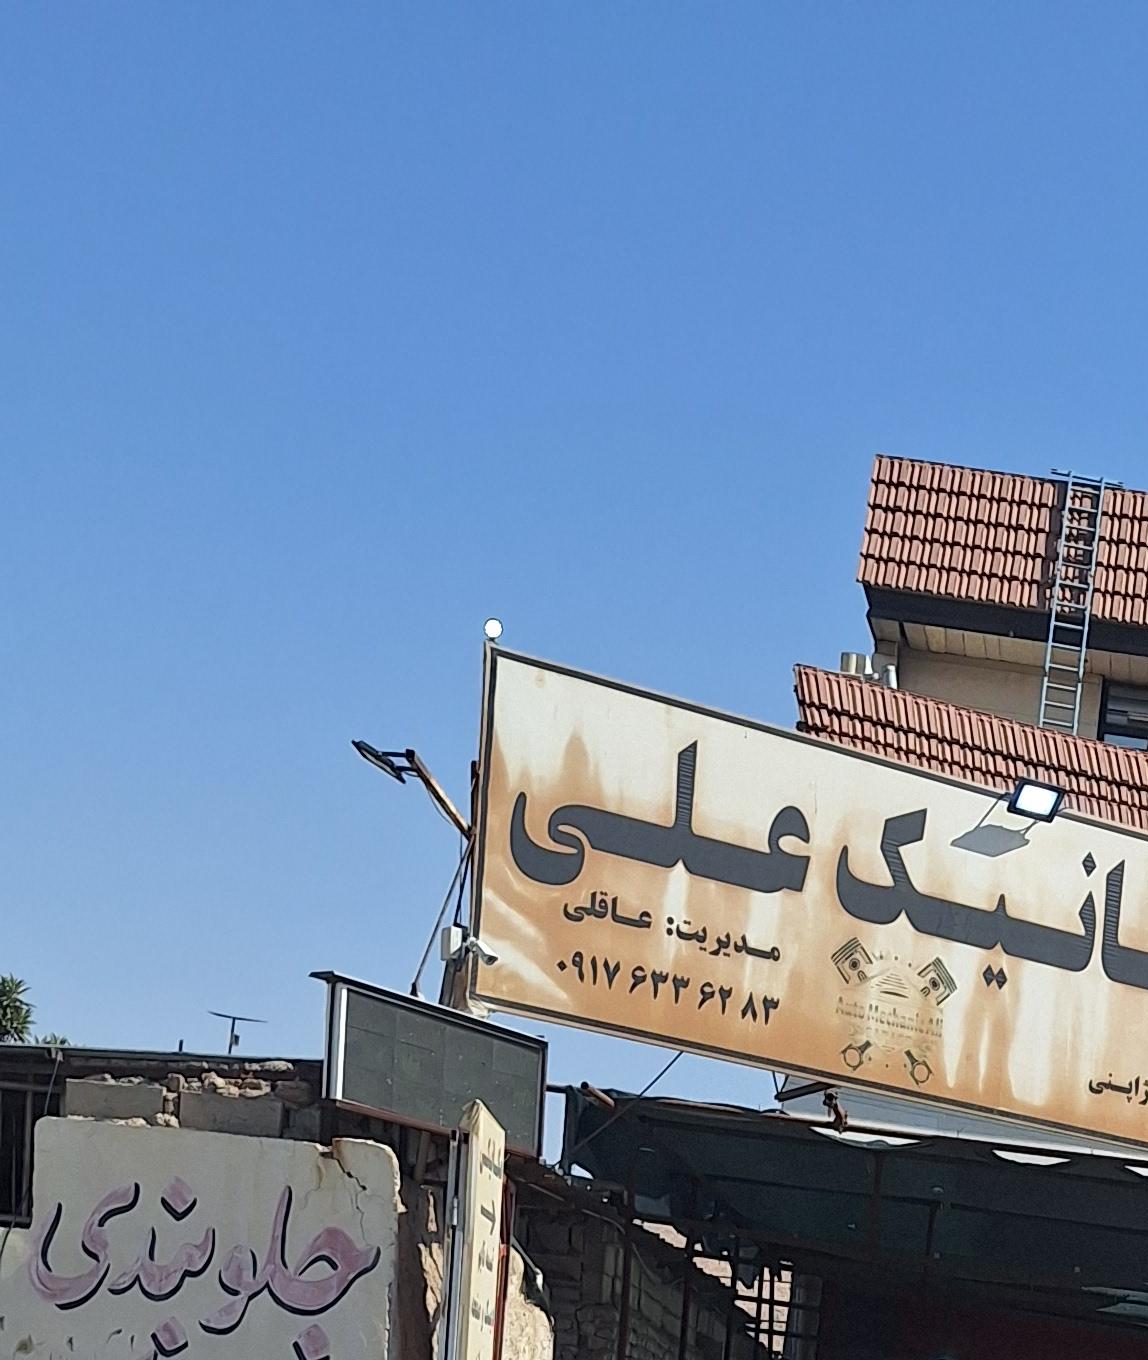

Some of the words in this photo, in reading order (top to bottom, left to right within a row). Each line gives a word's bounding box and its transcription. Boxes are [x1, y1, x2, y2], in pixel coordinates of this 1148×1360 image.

[510, 740, 811, 893] علی
[563, 890, 653, 929] عاقلی
[666, 915, 781, 962] مدیریت:
